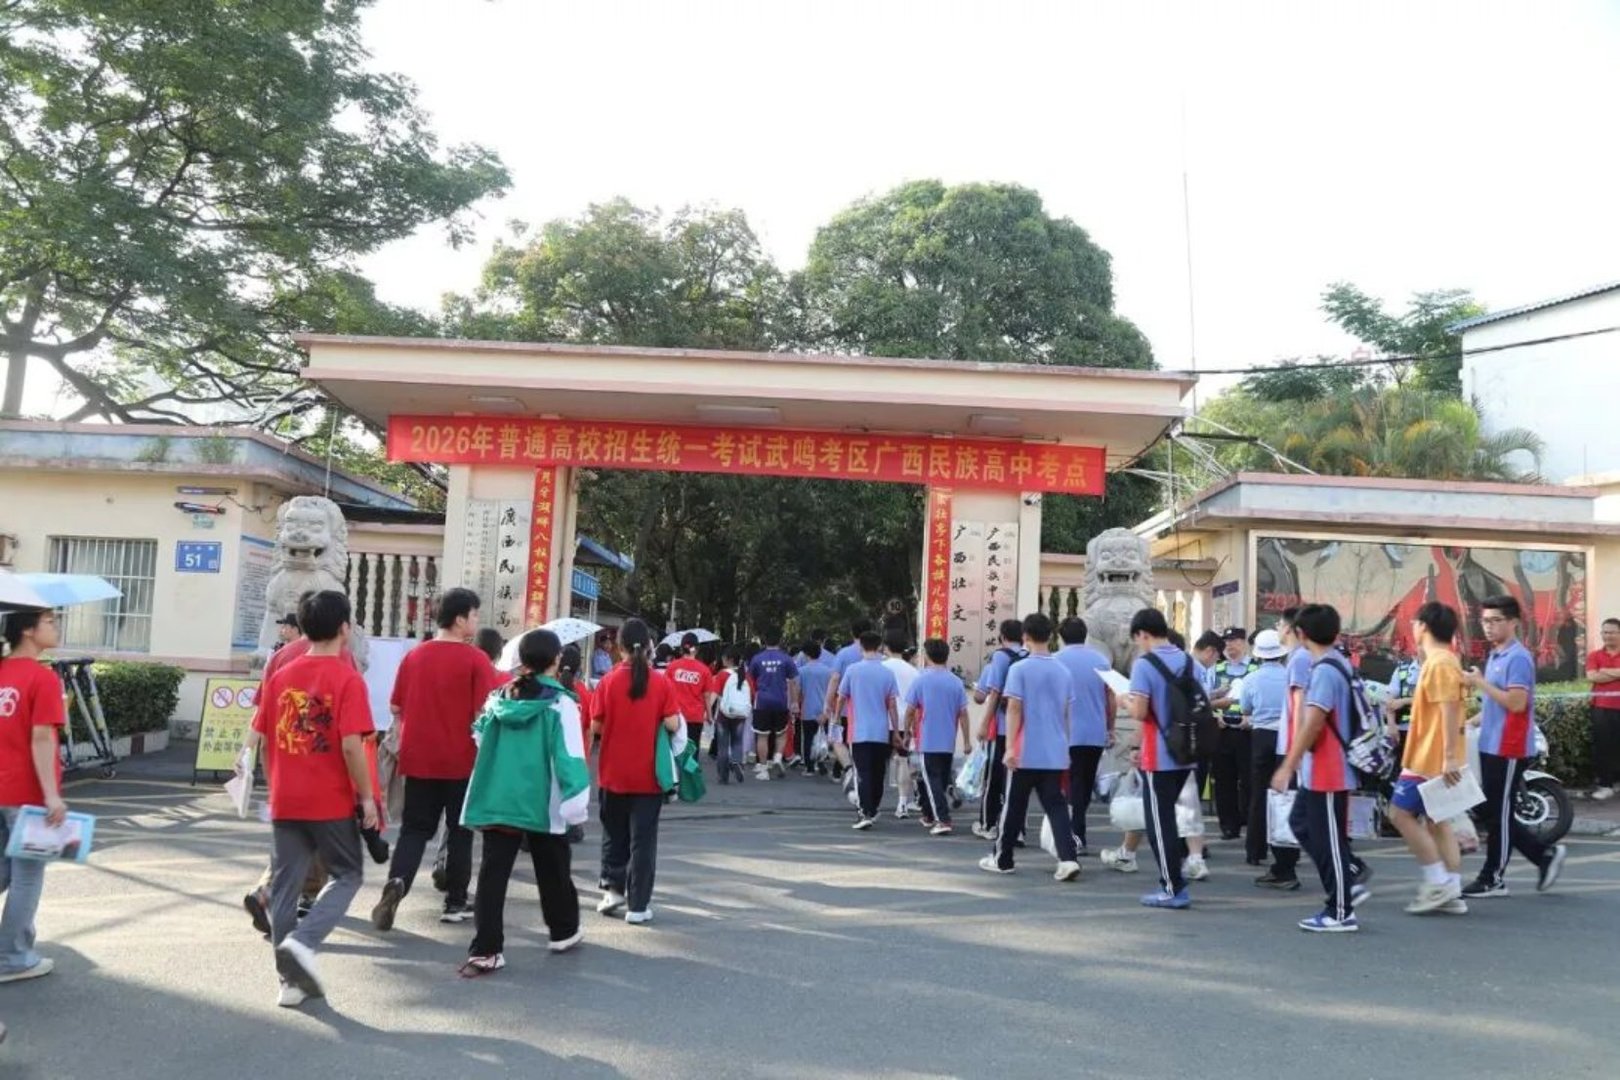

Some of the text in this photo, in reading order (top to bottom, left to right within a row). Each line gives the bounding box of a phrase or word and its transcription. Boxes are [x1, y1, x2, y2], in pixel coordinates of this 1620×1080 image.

[411, 424, 1088, 488] 2026年普通高校招生统一考试武鸣考区广西民族高中考点
[184, 553, 201, 568] 51
[497, 507, 516, 645] 廣西民族高
[984, 527, 1000, 661] 广西民族中等专业
